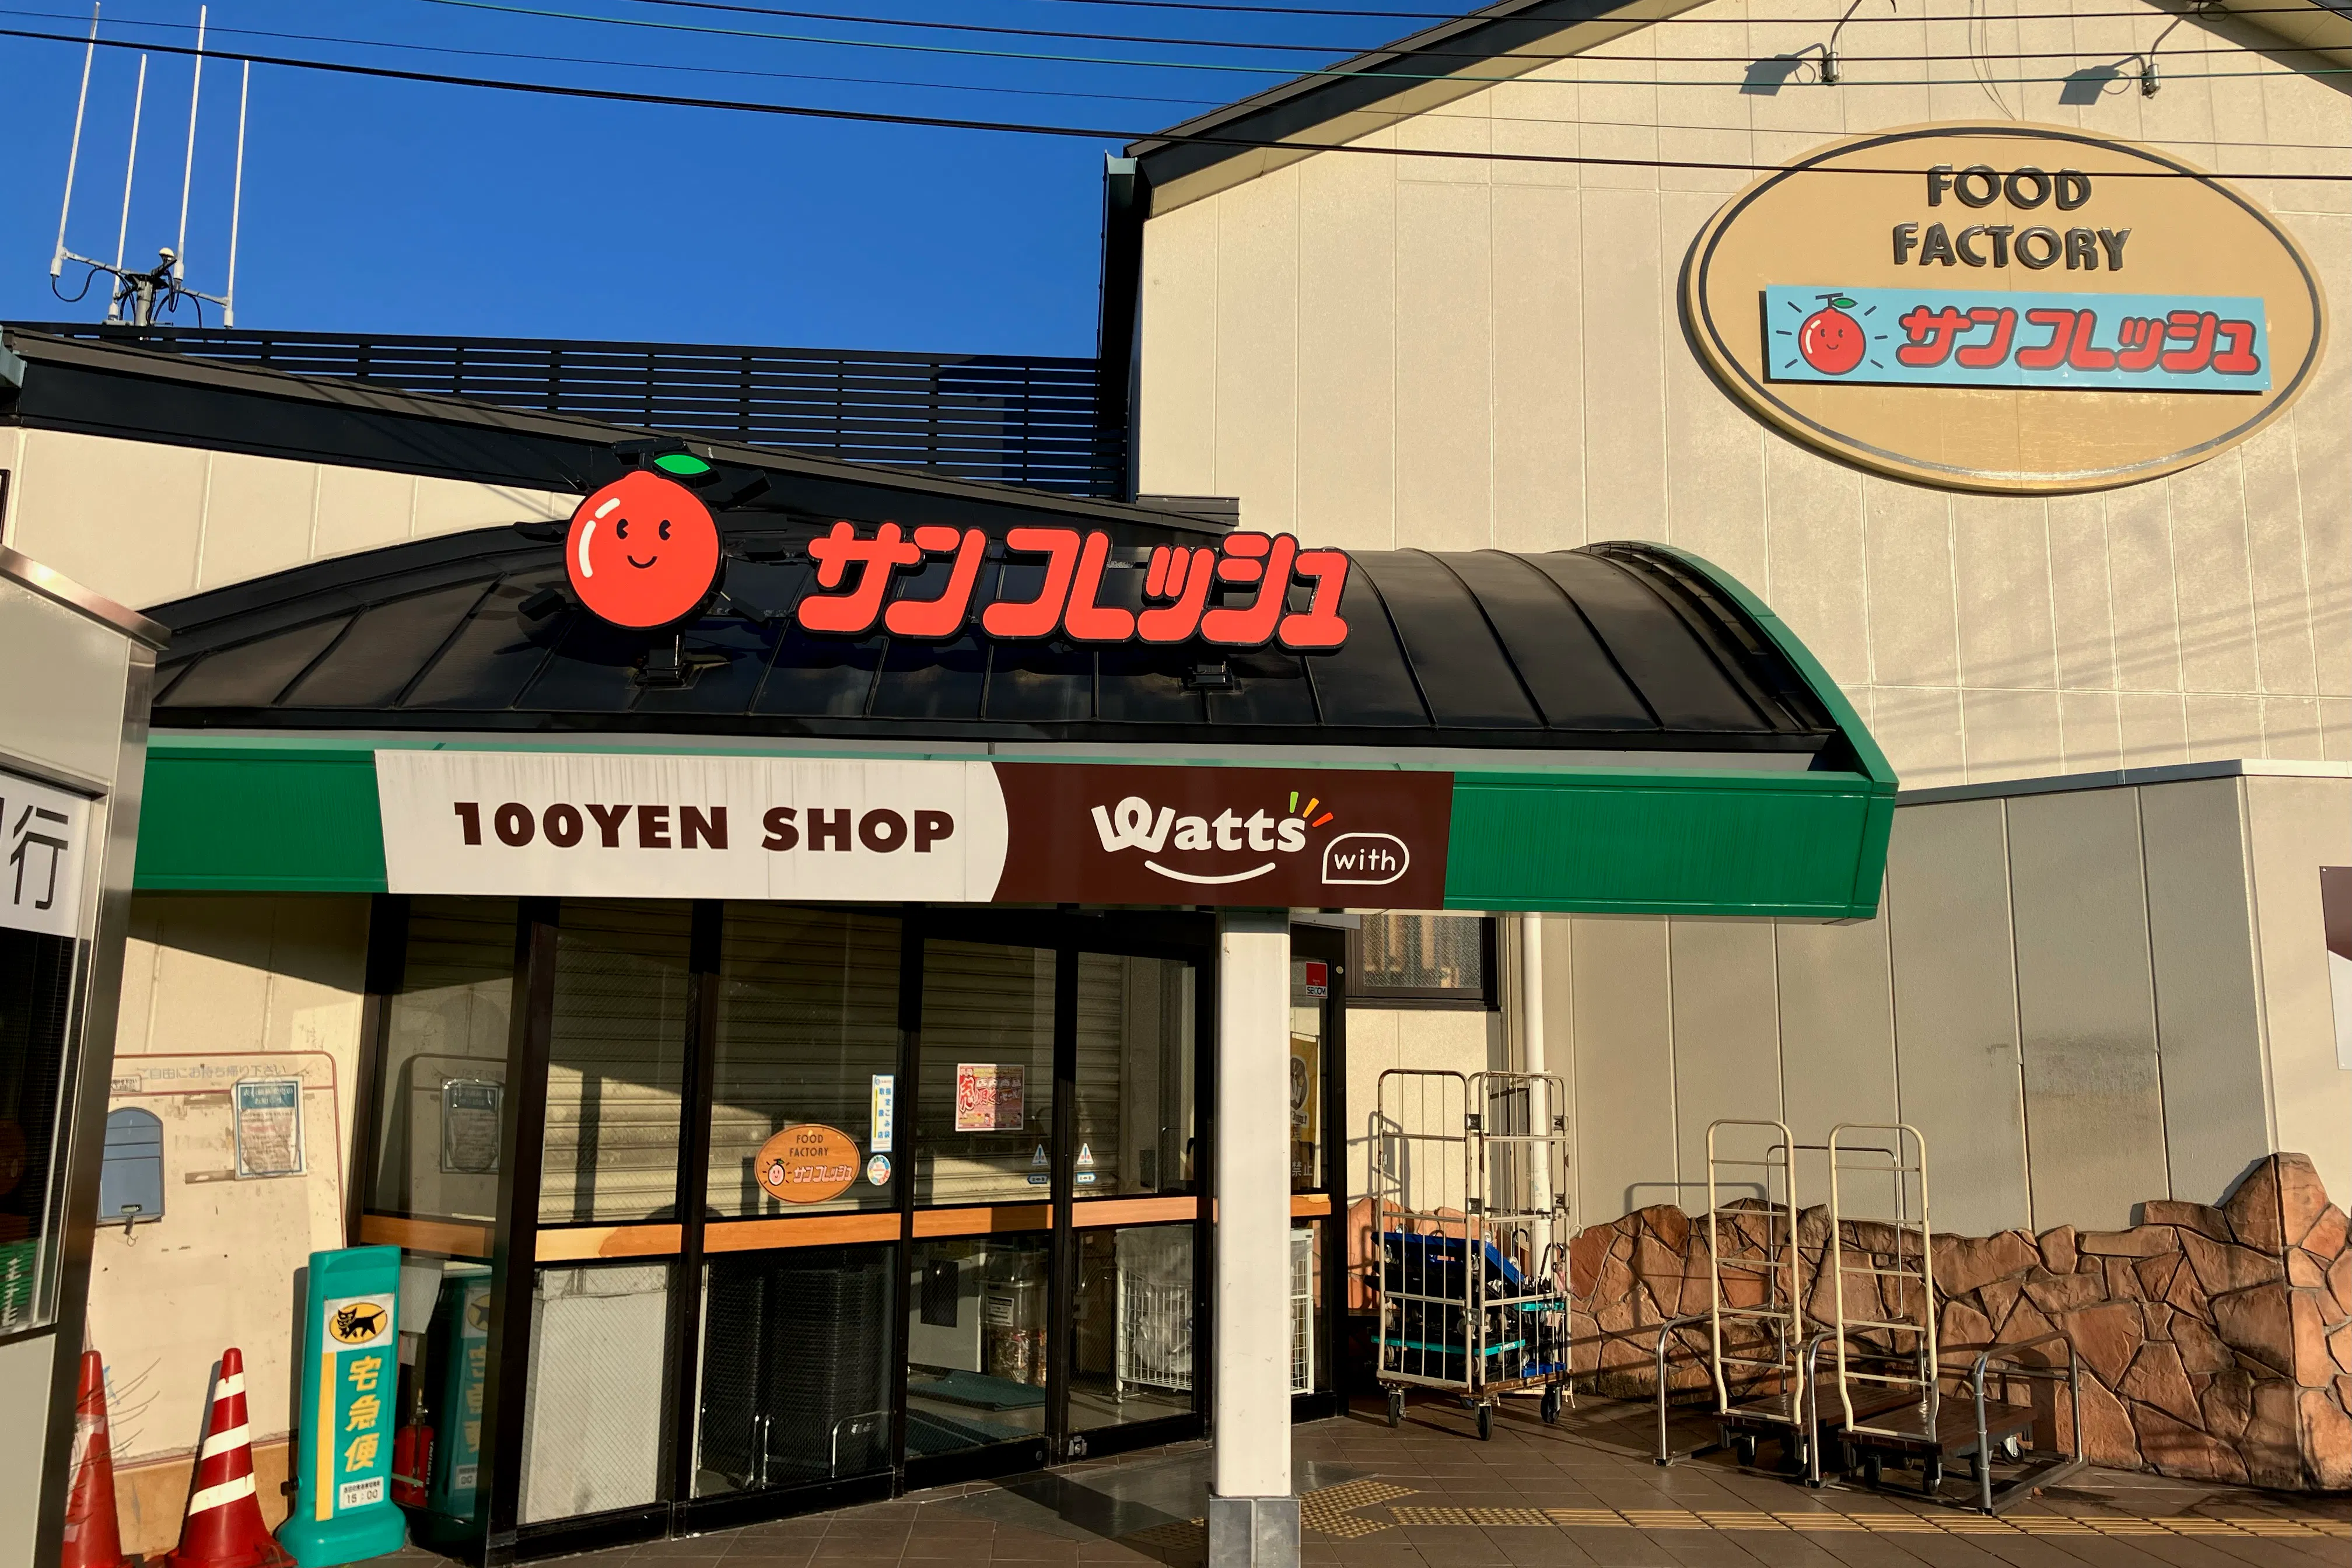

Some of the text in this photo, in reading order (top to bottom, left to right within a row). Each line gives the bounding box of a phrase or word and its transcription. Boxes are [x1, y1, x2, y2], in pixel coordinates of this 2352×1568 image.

[1927, 163, 2092, 211] FOOD
[1893, 222, 2132, 271] FACTORY
[1896, 304, 2262, 376] サンフレッシュ
[797, 520, 1351, 649] サンフレッシュ
[454, 802, 955, 853] 100YEN SHOP
[1091, 796, 1306, 853] Watts
[0, 797, 69, 910] 行
[1334, 848, 1396, 872] with
[1307, 986, 1326, 995] SECOM
[789, 1147, 829, 1157] FACTORY
[796, 1134, 824, 1144] FOOD
[793, 1164, 853, 1183] サンフレッシュ
[1292, 1160, 1314, 1177] 禁止
[345, 1355, 382, 1472] 宅急便
